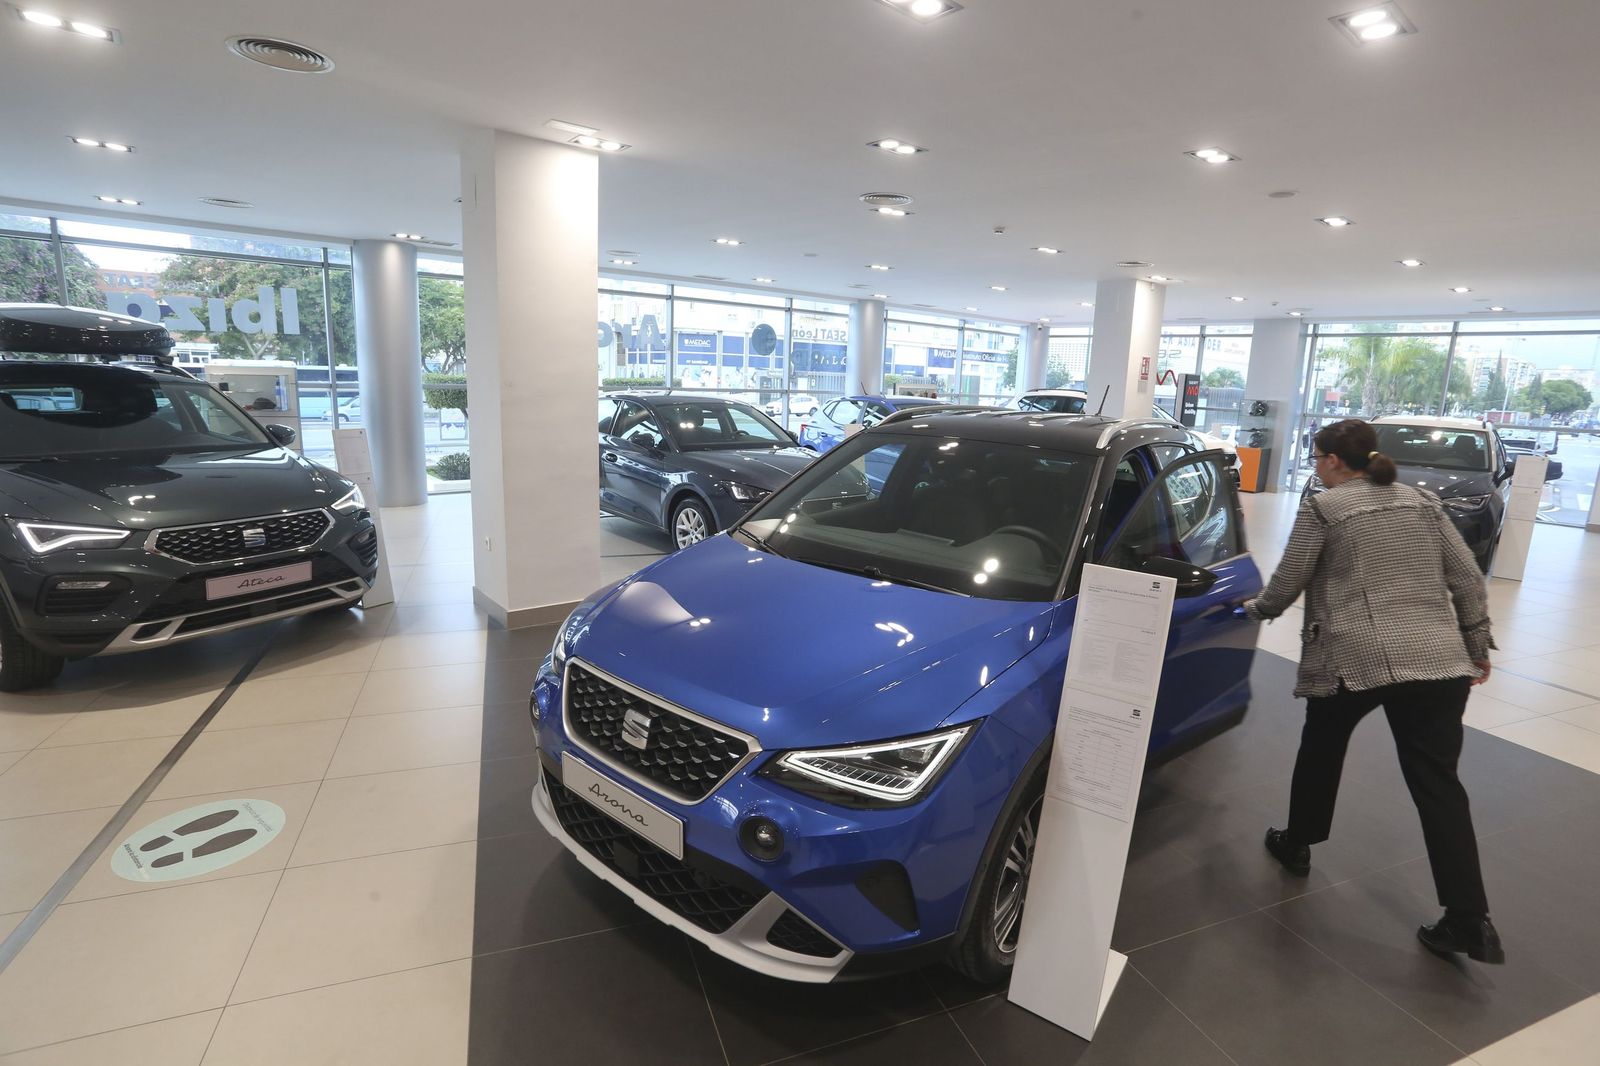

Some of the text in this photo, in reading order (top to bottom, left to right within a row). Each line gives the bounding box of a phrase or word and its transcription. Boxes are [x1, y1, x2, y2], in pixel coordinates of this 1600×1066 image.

[937, 349, 957, 359] MEDA
[237, 575, 286, 589] Ateca
[588, 783, 648, 827] Arona
